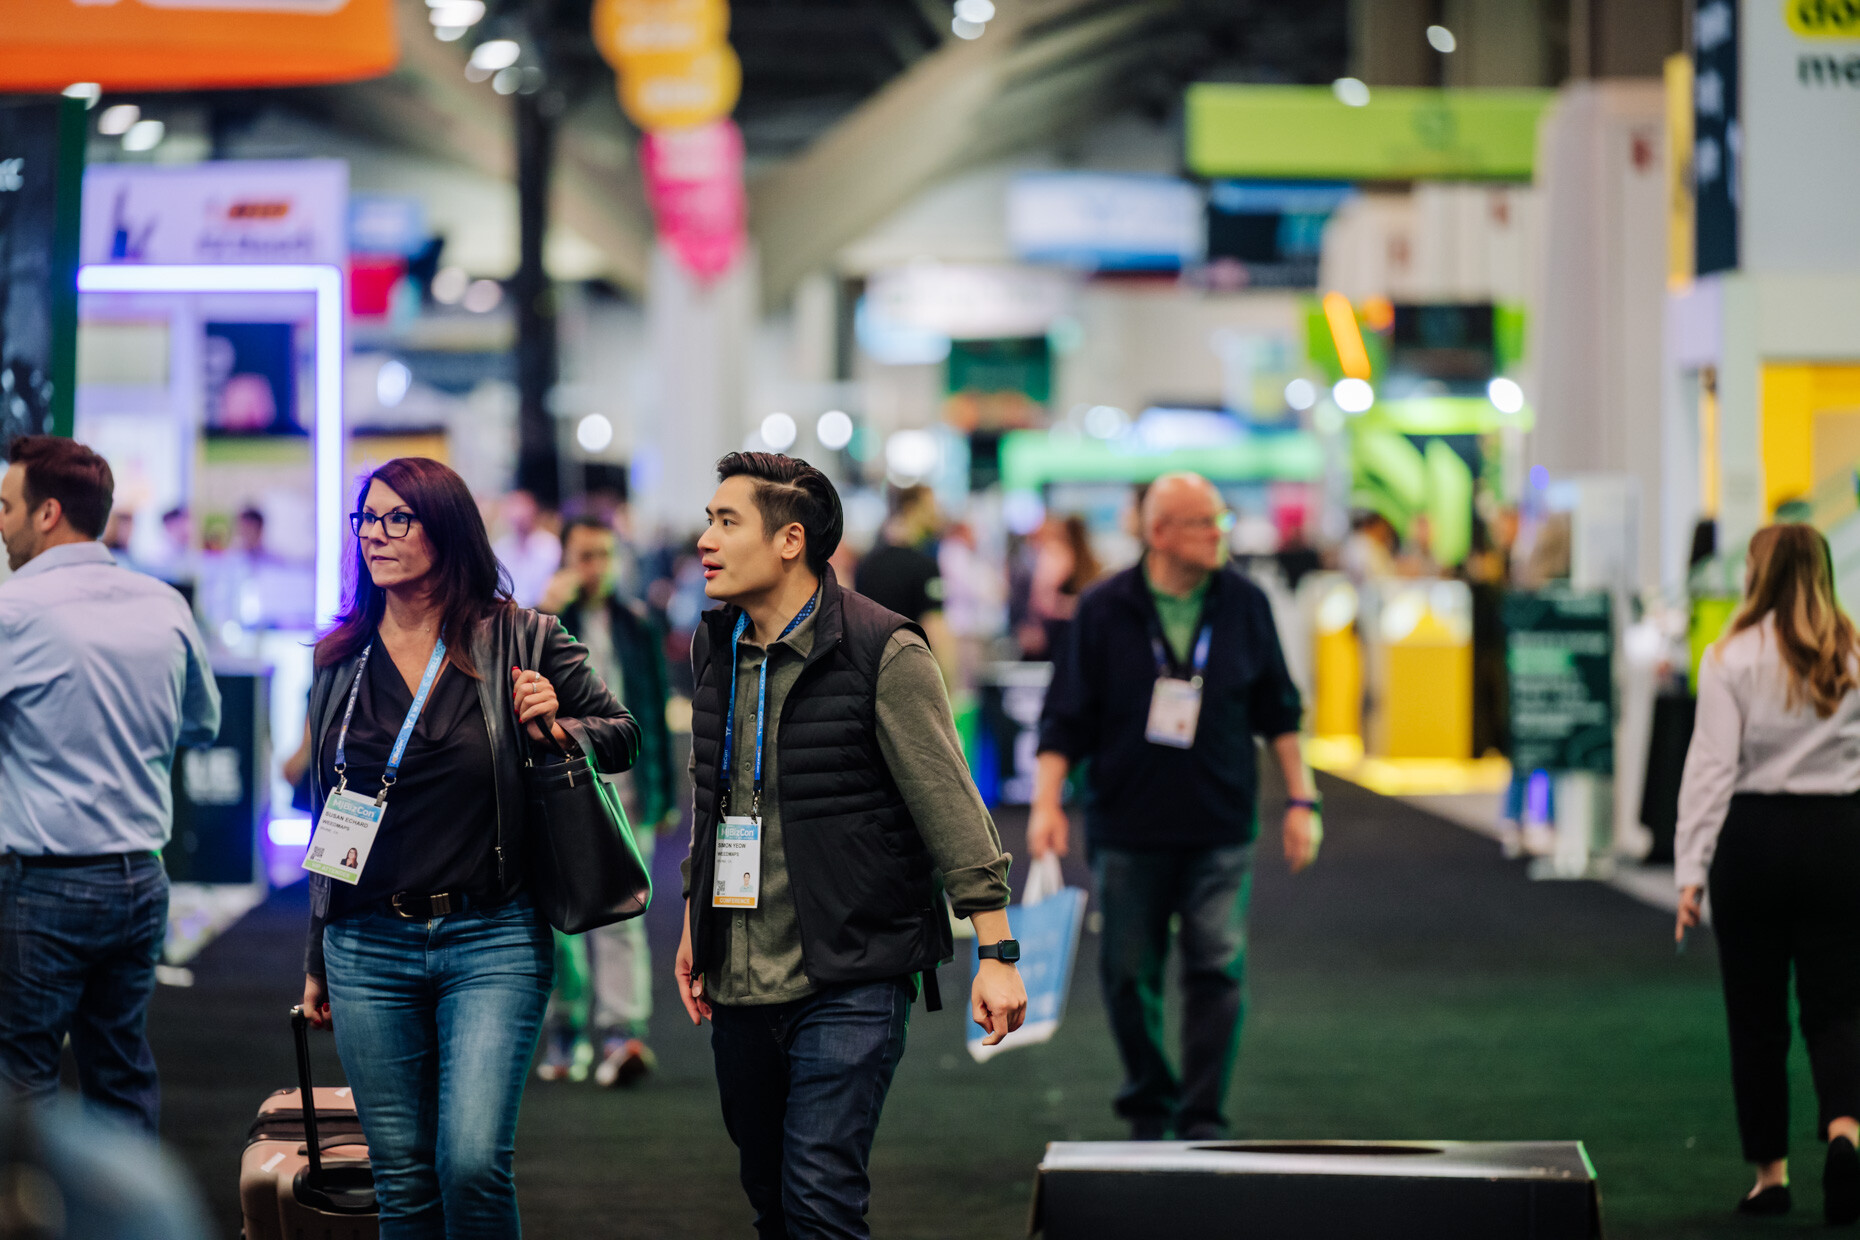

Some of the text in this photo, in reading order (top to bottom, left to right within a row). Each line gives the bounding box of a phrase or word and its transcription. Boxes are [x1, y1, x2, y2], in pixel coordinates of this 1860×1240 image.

[332, 799, 375, 818] MJBizCon
[325, 811, 344, 821] SUSAN
[345, 817, 369, 829] ECHARD
[720, 828, 754, 837] MJBizCon
